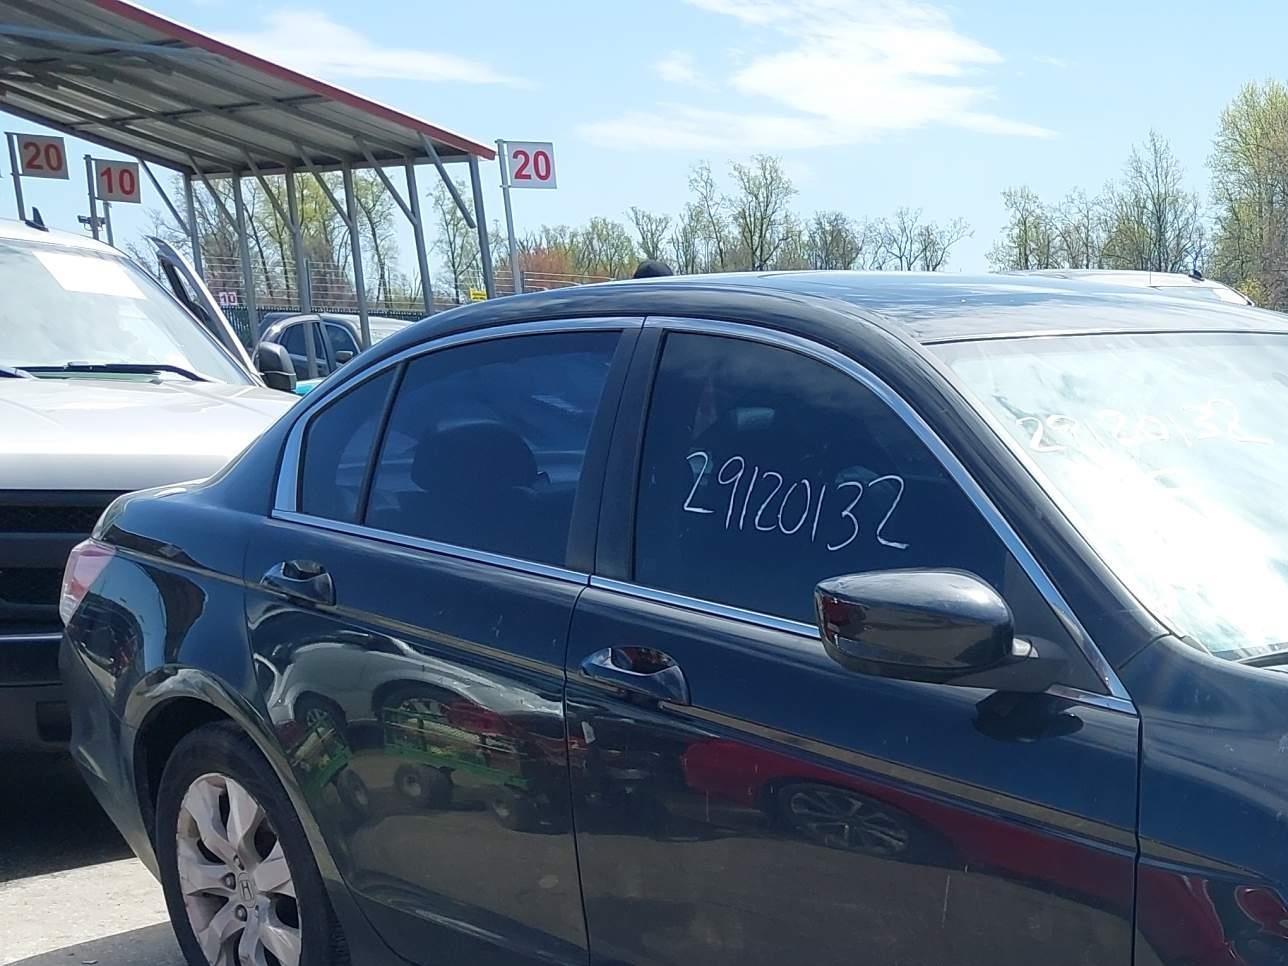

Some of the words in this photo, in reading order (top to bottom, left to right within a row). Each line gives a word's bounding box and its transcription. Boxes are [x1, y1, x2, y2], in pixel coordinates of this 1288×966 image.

[23, 141, 63, 171] 20
[512, 150, 551, 181] 20
[100, 167, 136, 196] 10
[220, 293, 236, 304] 10
